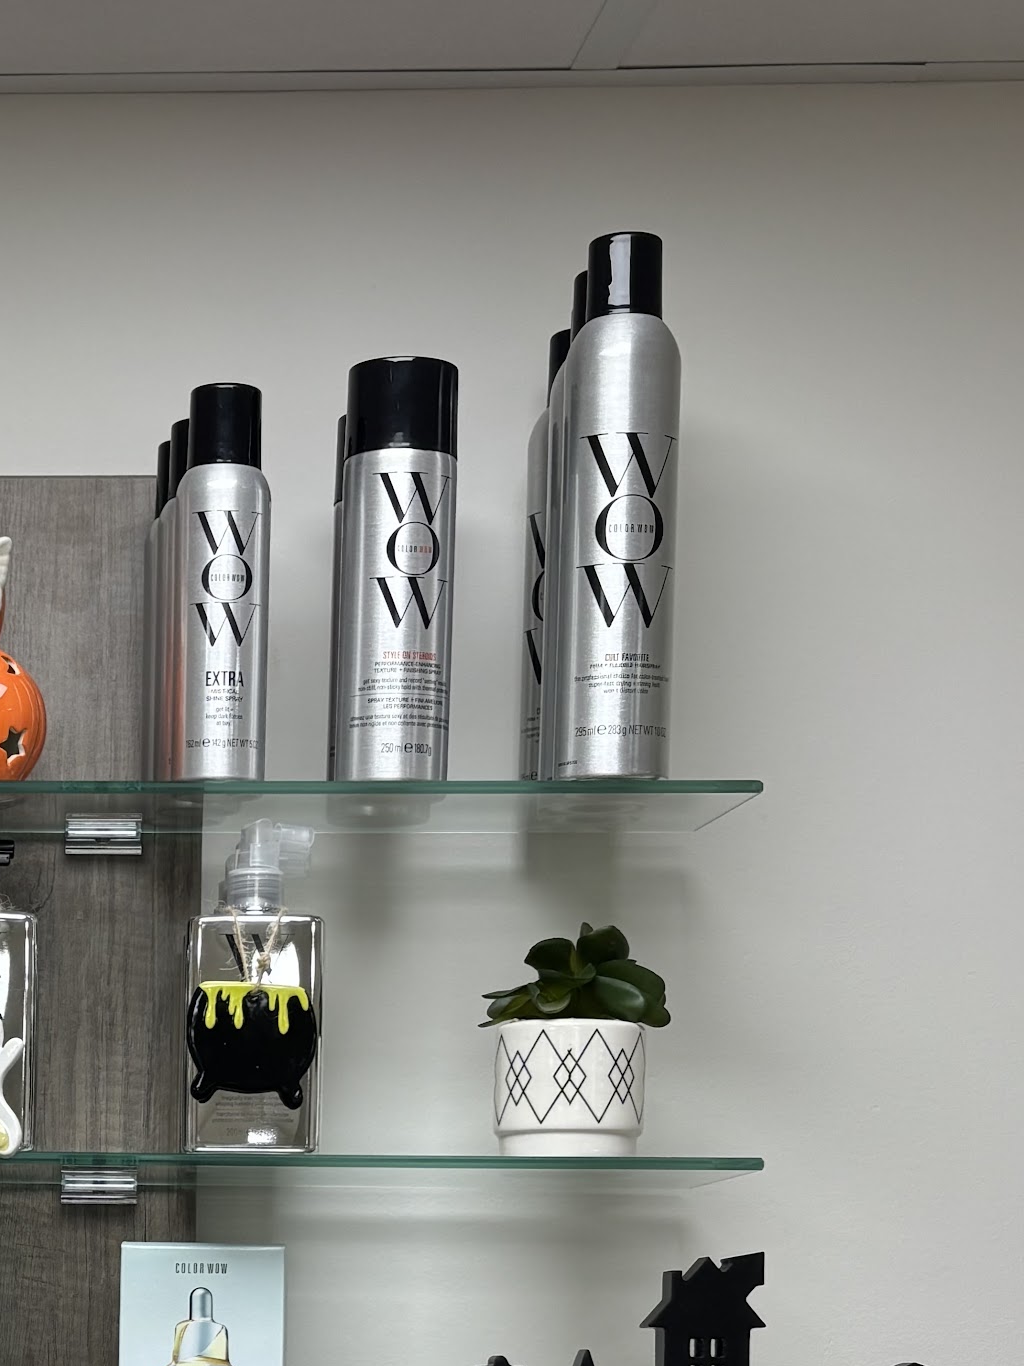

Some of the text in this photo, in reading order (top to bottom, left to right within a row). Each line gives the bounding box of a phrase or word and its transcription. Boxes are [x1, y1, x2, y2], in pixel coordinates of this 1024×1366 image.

[576, 432, 677, 628] WOW
[369, 472, 451, 630] WOW
[190, 510, 263, 647] WOW
[205, 670, 245, 687] EXTRA
[628, 724, 642, 735] NET
[644, 726, 654, 736] WT
[381, 742, 394, 753] 250
[176, 1262, 228, 1274] COLOR WOW
